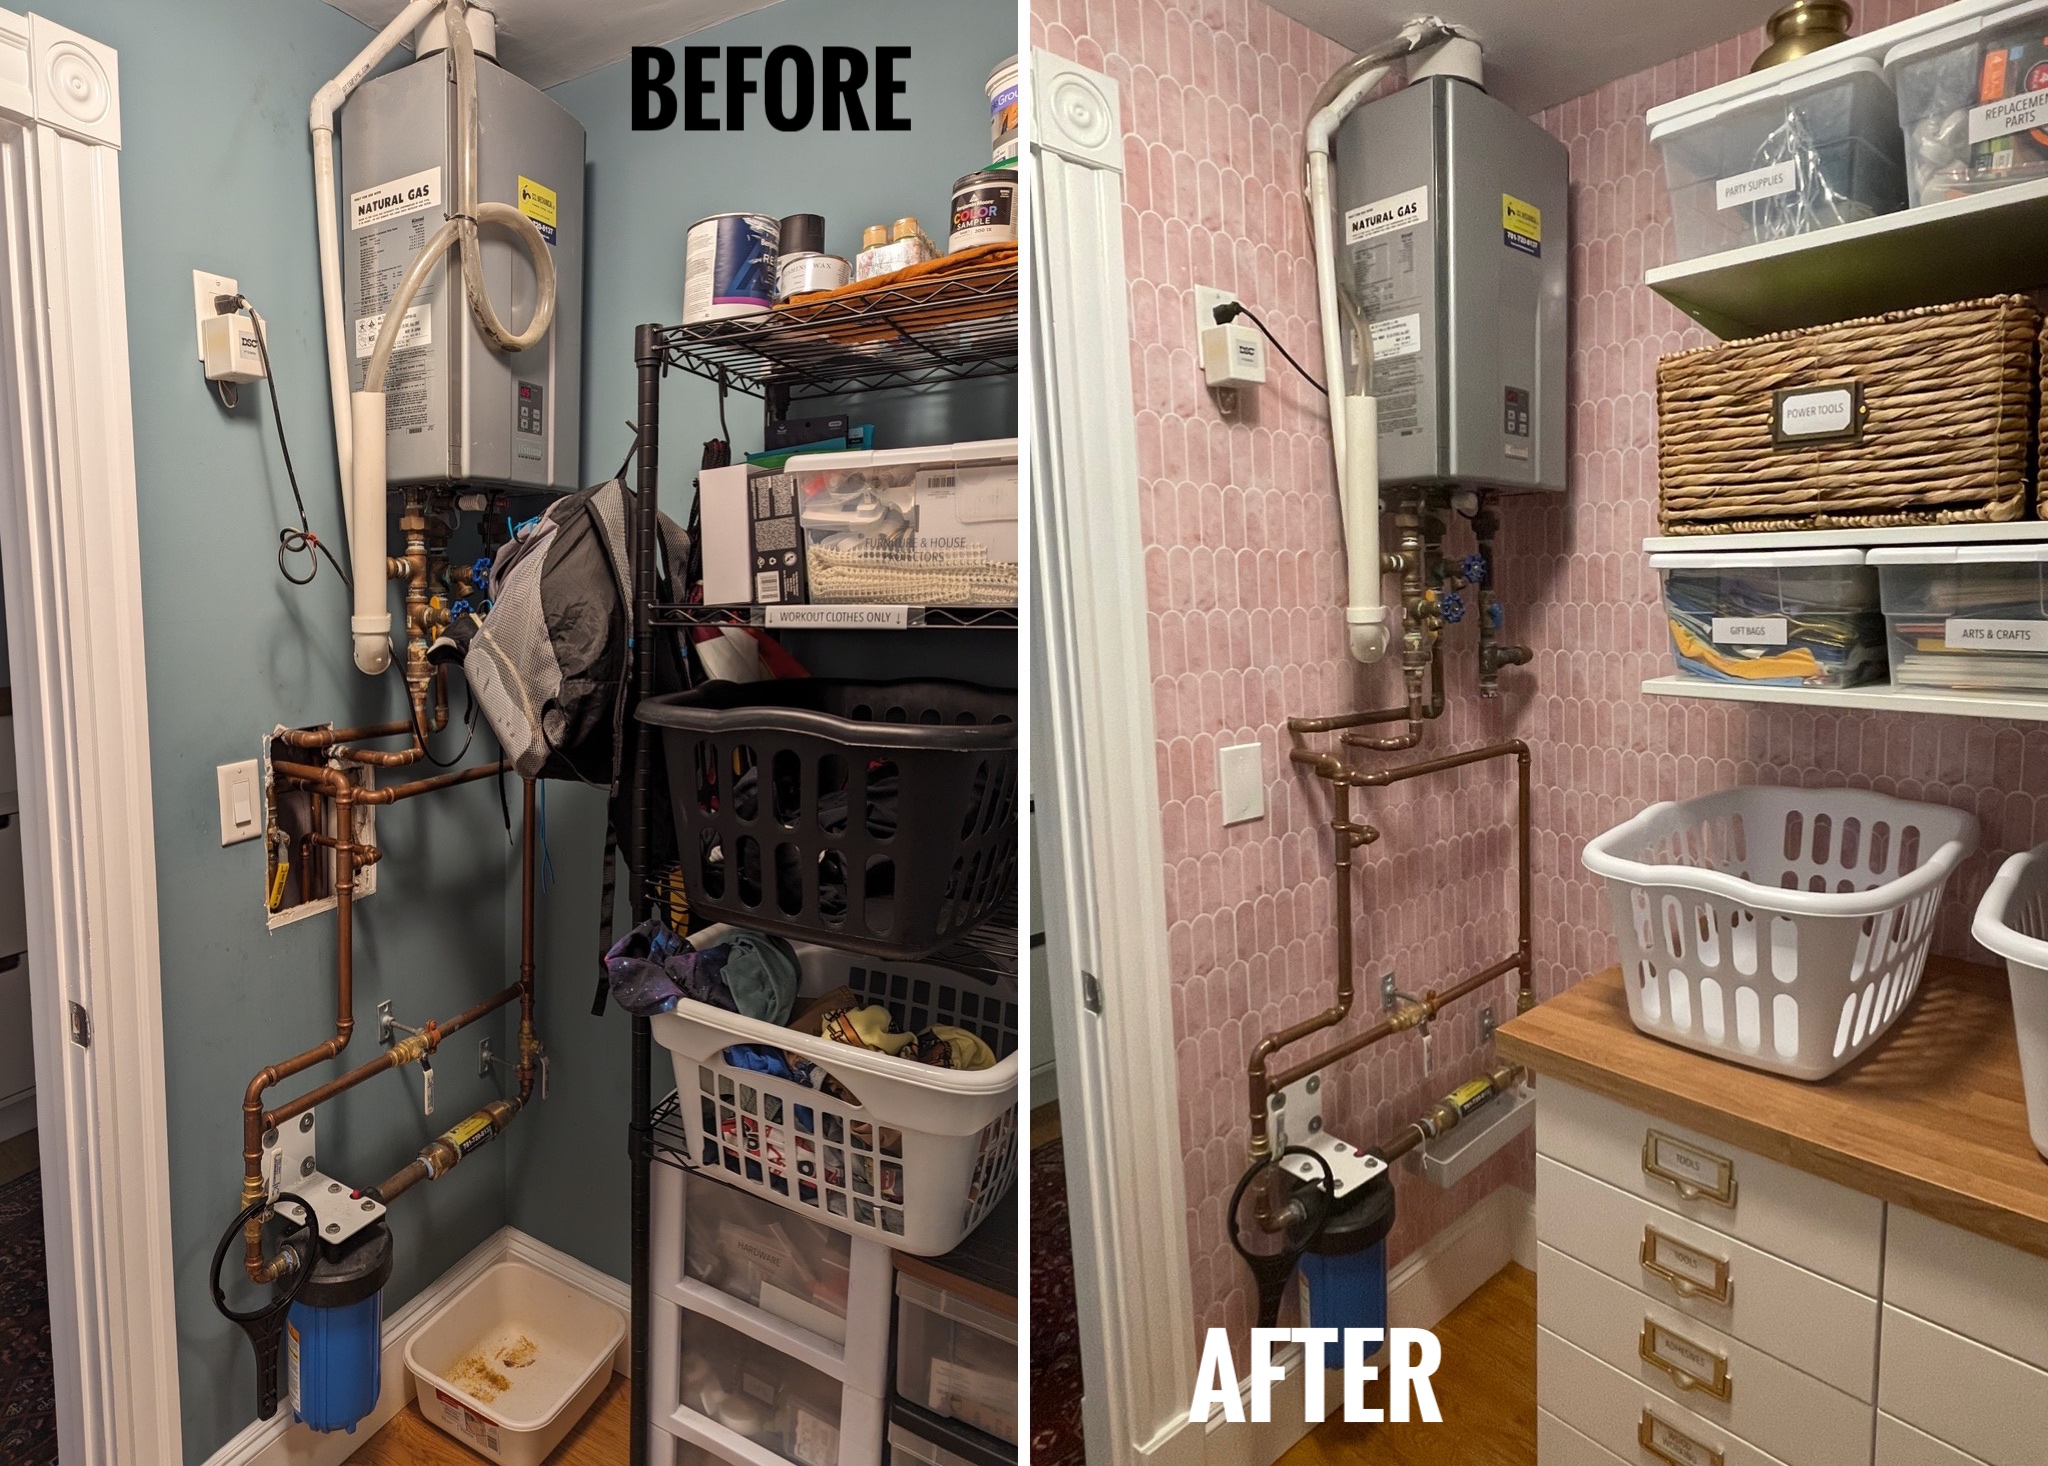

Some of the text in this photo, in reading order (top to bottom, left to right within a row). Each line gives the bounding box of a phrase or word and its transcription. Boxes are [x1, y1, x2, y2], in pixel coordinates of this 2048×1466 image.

[2005, 110, 2036, 128] PARTS
[1725, 173, 1784, 198] PARTY SUPPLIES
[358, 193, 404, 216] NATURAL
[407, 184, 430, 201] GAS
[954, 205, 998, 225] COLOR
[1352, 210, 1394, 232] NATURAL
[1397, 202, 1417, 217] GAS
[957, 217, 991, 230] SAMPLE
[241, 337, 258, 348] DSC
[1787, 403, 1844, 419] POWER TOOLS
[865, 537, 966, 548] FURNITURE & HOUSE
[884, 551, 945, 562] PROTECTORS
[780, 612, 892, 623] WORKOUT CLOTHES ONLY
[1730, 626, 1766, 636] GIFT BAGS
[1962, 629, 2031, 640] ARTS & CRAFTS
[1676, 1153, 1700, 1171] TOOLS
[737, 1240, 780, 1268] HARDWARE
